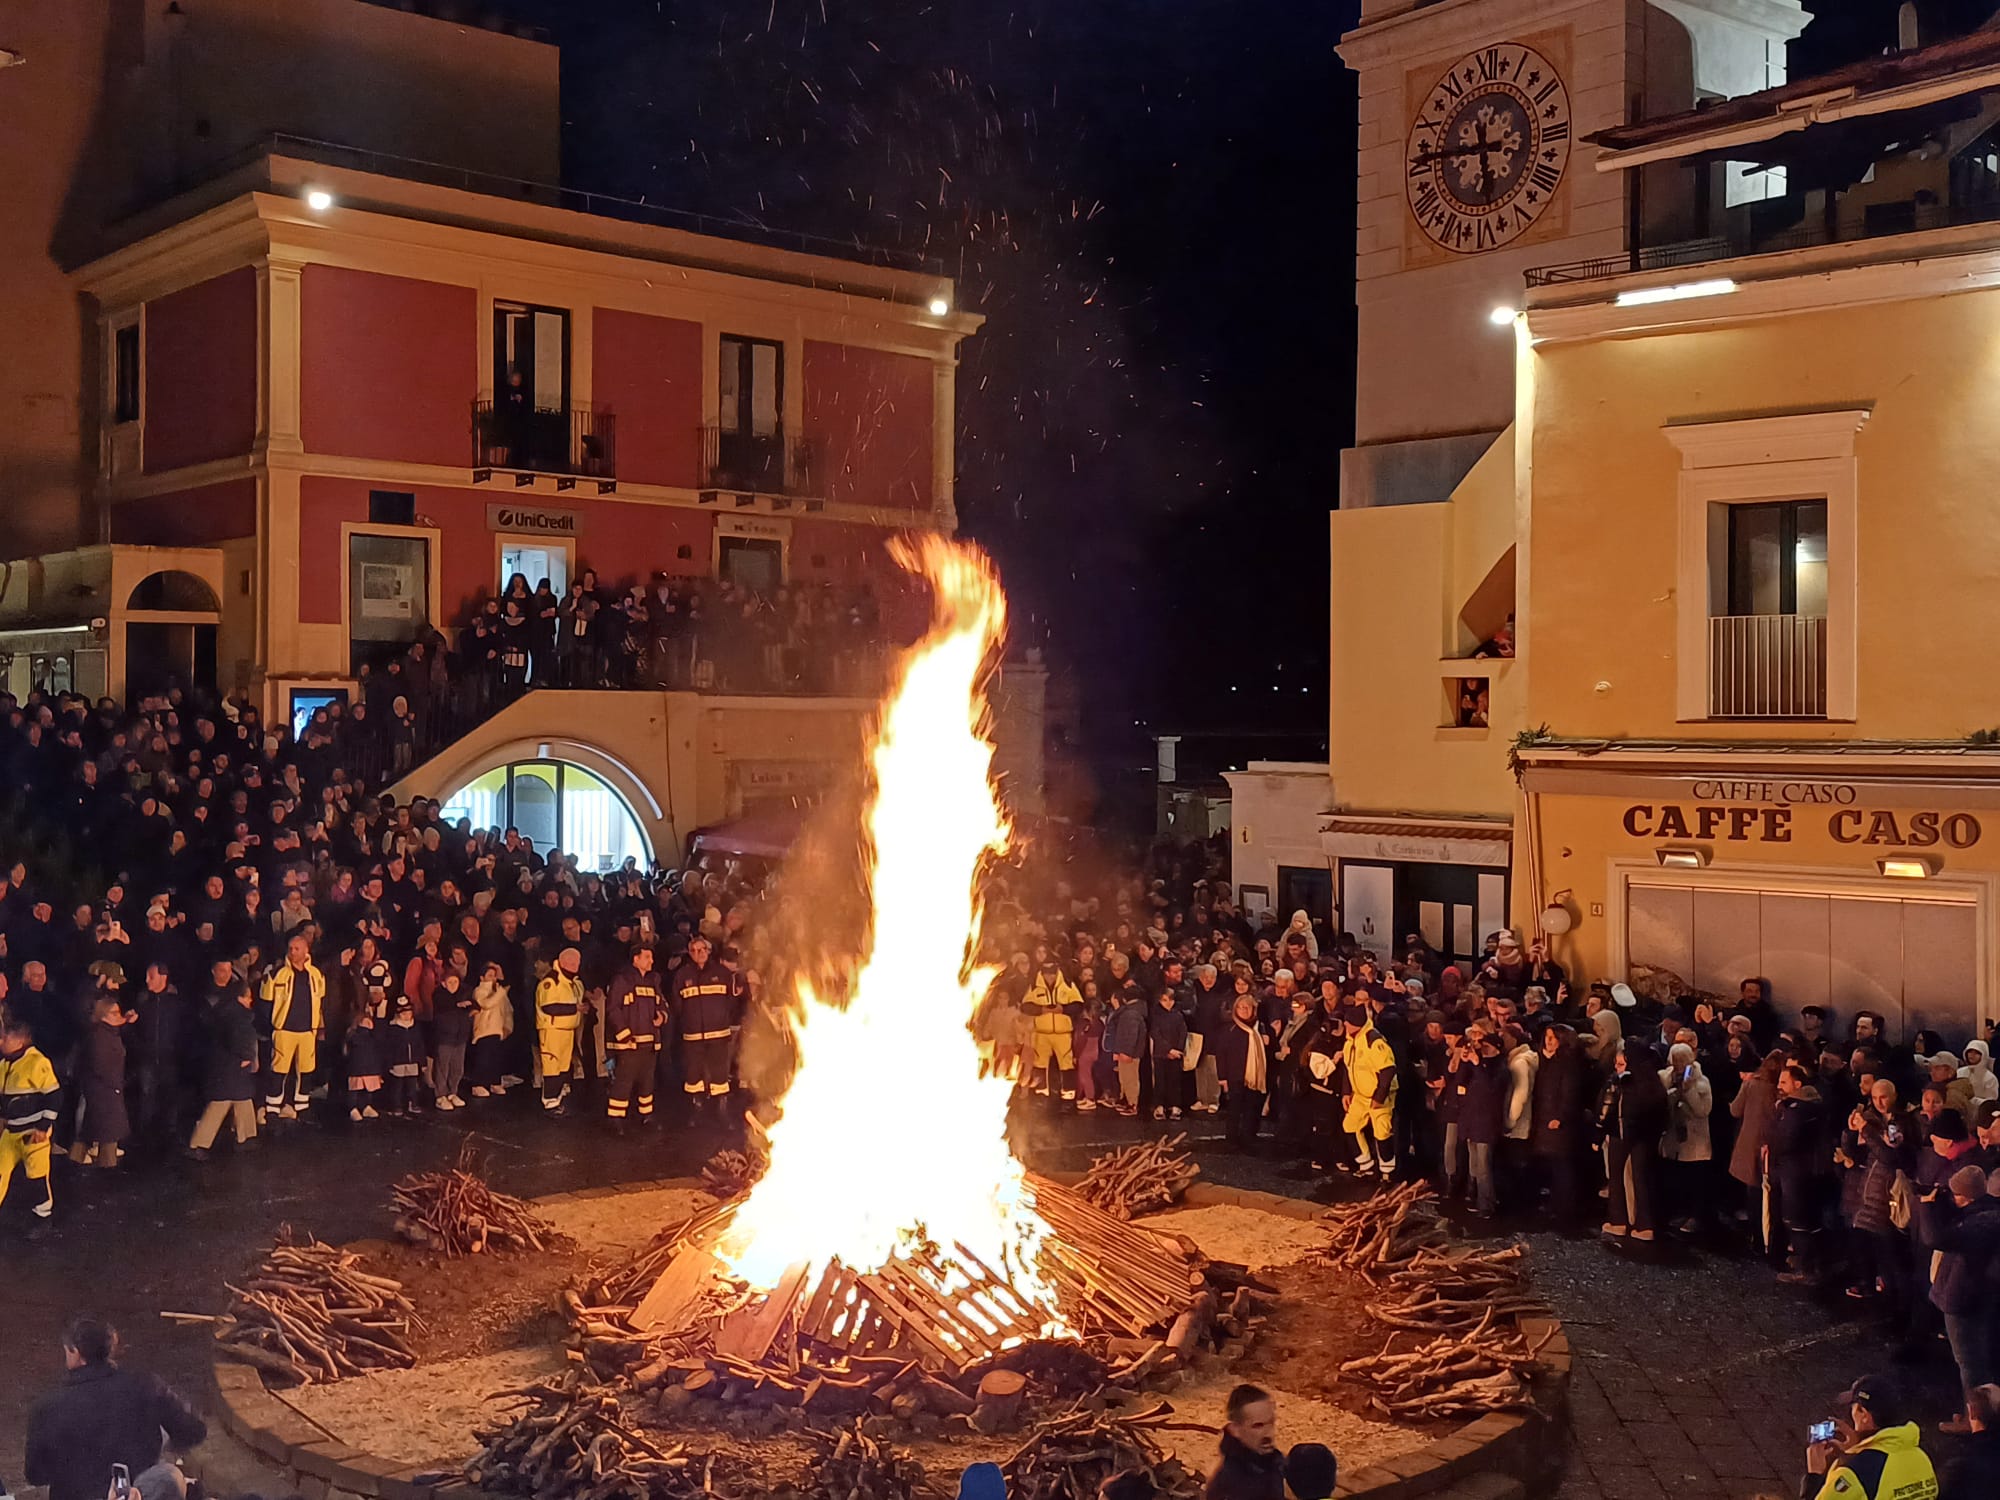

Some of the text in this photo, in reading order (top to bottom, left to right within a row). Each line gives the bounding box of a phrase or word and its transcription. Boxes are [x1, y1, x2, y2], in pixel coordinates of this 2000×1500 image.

[1475, 48, 1498, 84] XII
[1513, 51, 1529, 82] I
[1439, 71, 1464, 104] XI
[1533, 77, 1560, 105] II
[1415, 114, 1442, 136] X
[1542, 120, 1568, 143] III
[1530, 162, 1560, 194] IIII
[1513, 203, 1533, 231] V
[1477, 218, 1497, 249] VI
[515, 512, 574, 530] UniCredit
[1693, 781, 1857, 805] CAFFE CASO
[1828, 810, 1982, 849] CASO
